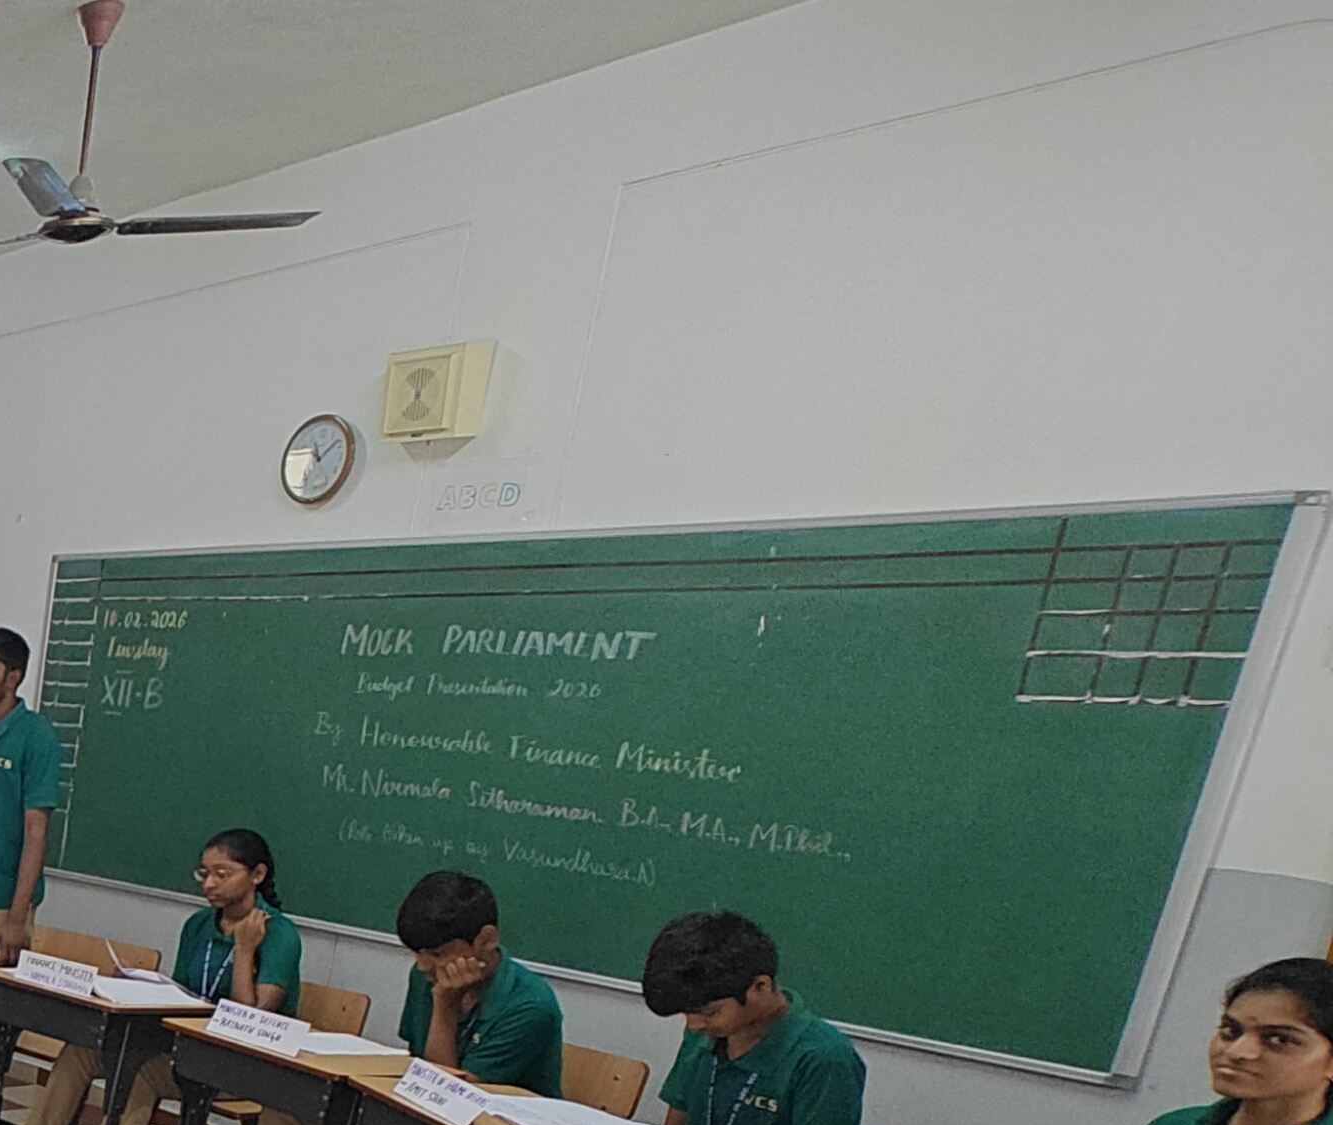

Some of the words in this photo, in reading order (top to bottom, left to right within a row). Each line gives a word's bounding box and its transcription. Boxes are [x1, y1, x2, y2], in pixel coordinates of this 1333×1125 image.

[436, 482, 521, 511] ABCD
[341, 624, 414, 656] MOCK
[442, 624, 658, 661] PARLIAMENT
[355, 672, 415, 700] Budget
[426, 673, 528, 698] Presentation
[546, 678, 601, 699] 2026
[314, 711, 344, 745] By
[508, 733, 601, 769] Finance
[615, 741, 742, 783] Minister
[360, 768, 451, 800] Nirmala
[404, 1081, 429, 1098] AMIT
[443, 1081, 467, 1096] HOME
